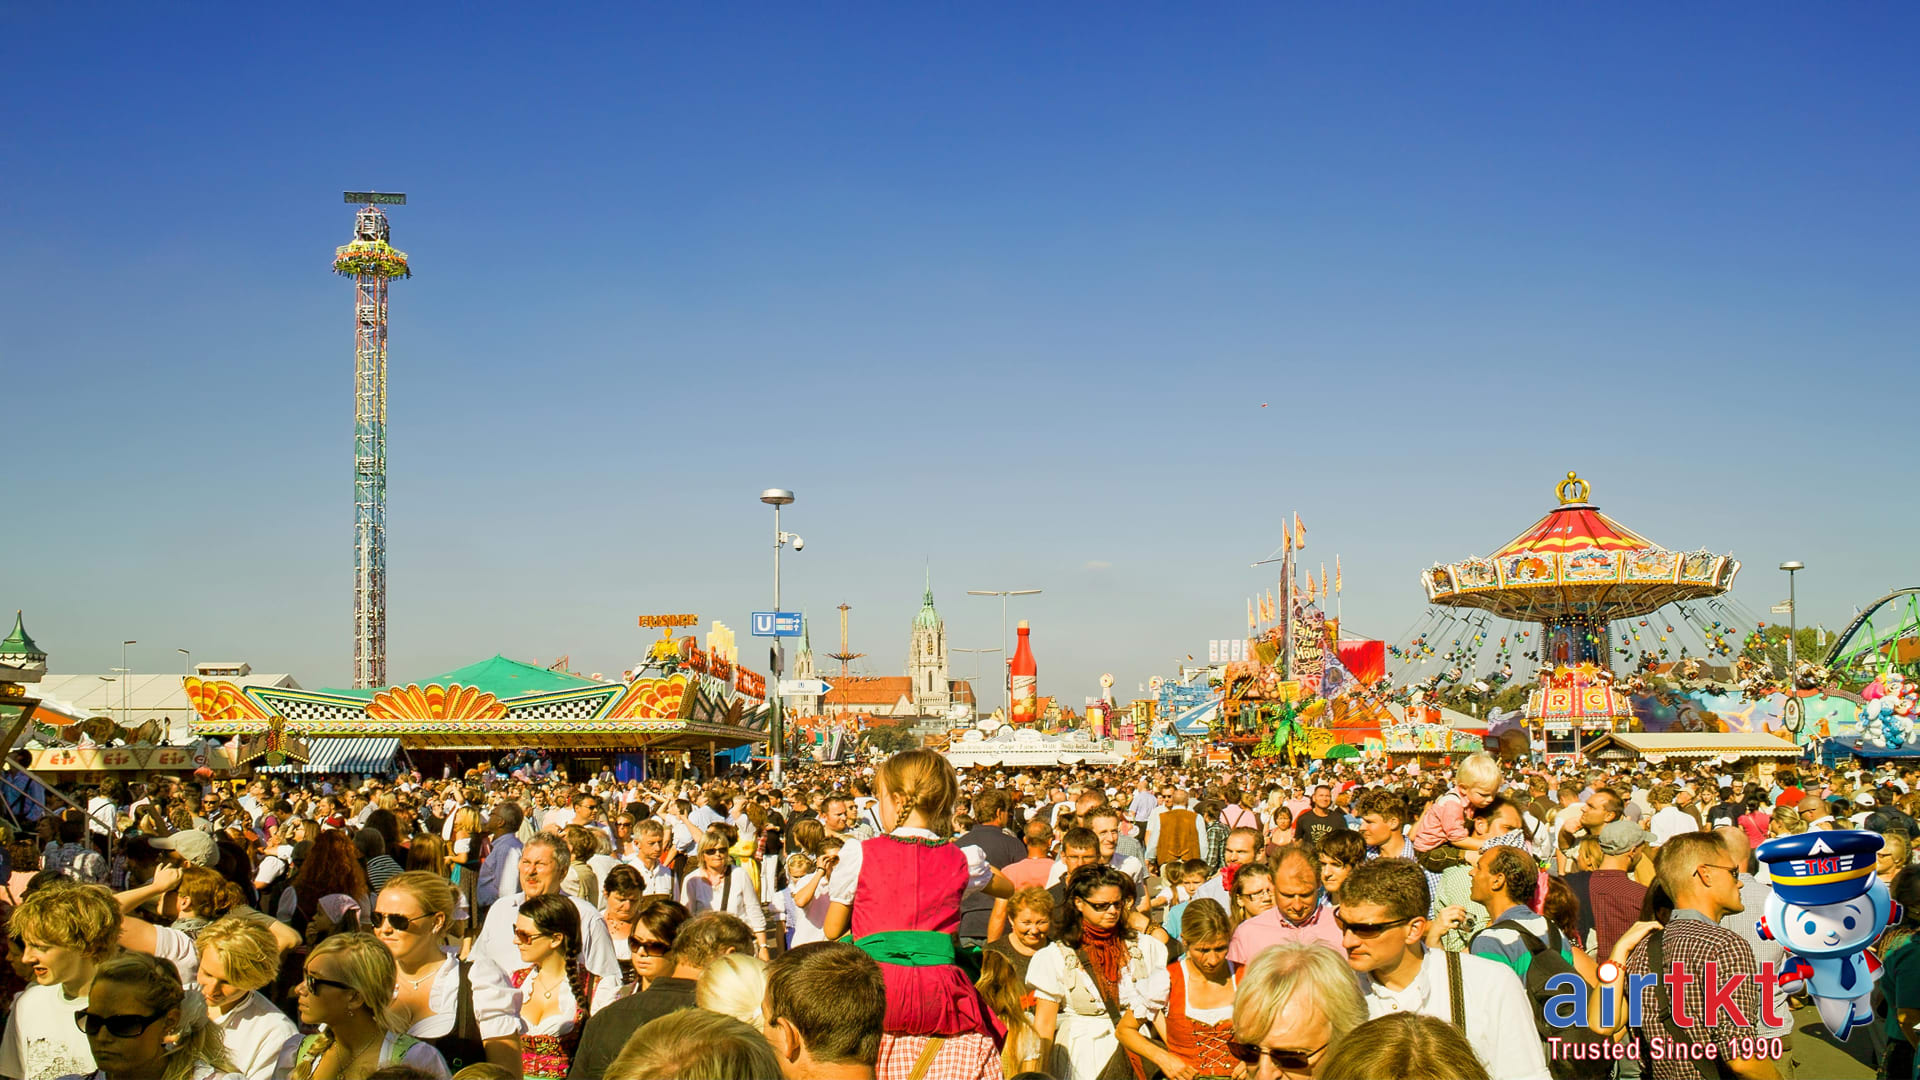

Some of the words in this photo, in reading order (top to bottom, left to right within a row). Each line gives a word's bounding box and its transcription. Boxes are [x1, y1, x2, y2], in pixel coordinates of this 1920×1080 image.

[757, 616, 772, 632] U
[1292, 619, 1324, 639] Fahrt
[1295, 646, 1323, 660] Hölle
[1552, 695, 1566, 706] R
[1589, 694, 1602, 705] C
[50, 753, 76, 765] Eis
[103, 752, 130, 765] Eis
[159, 752, 186, 765] Eis
[1311, 824, 1333, 833] POLO
